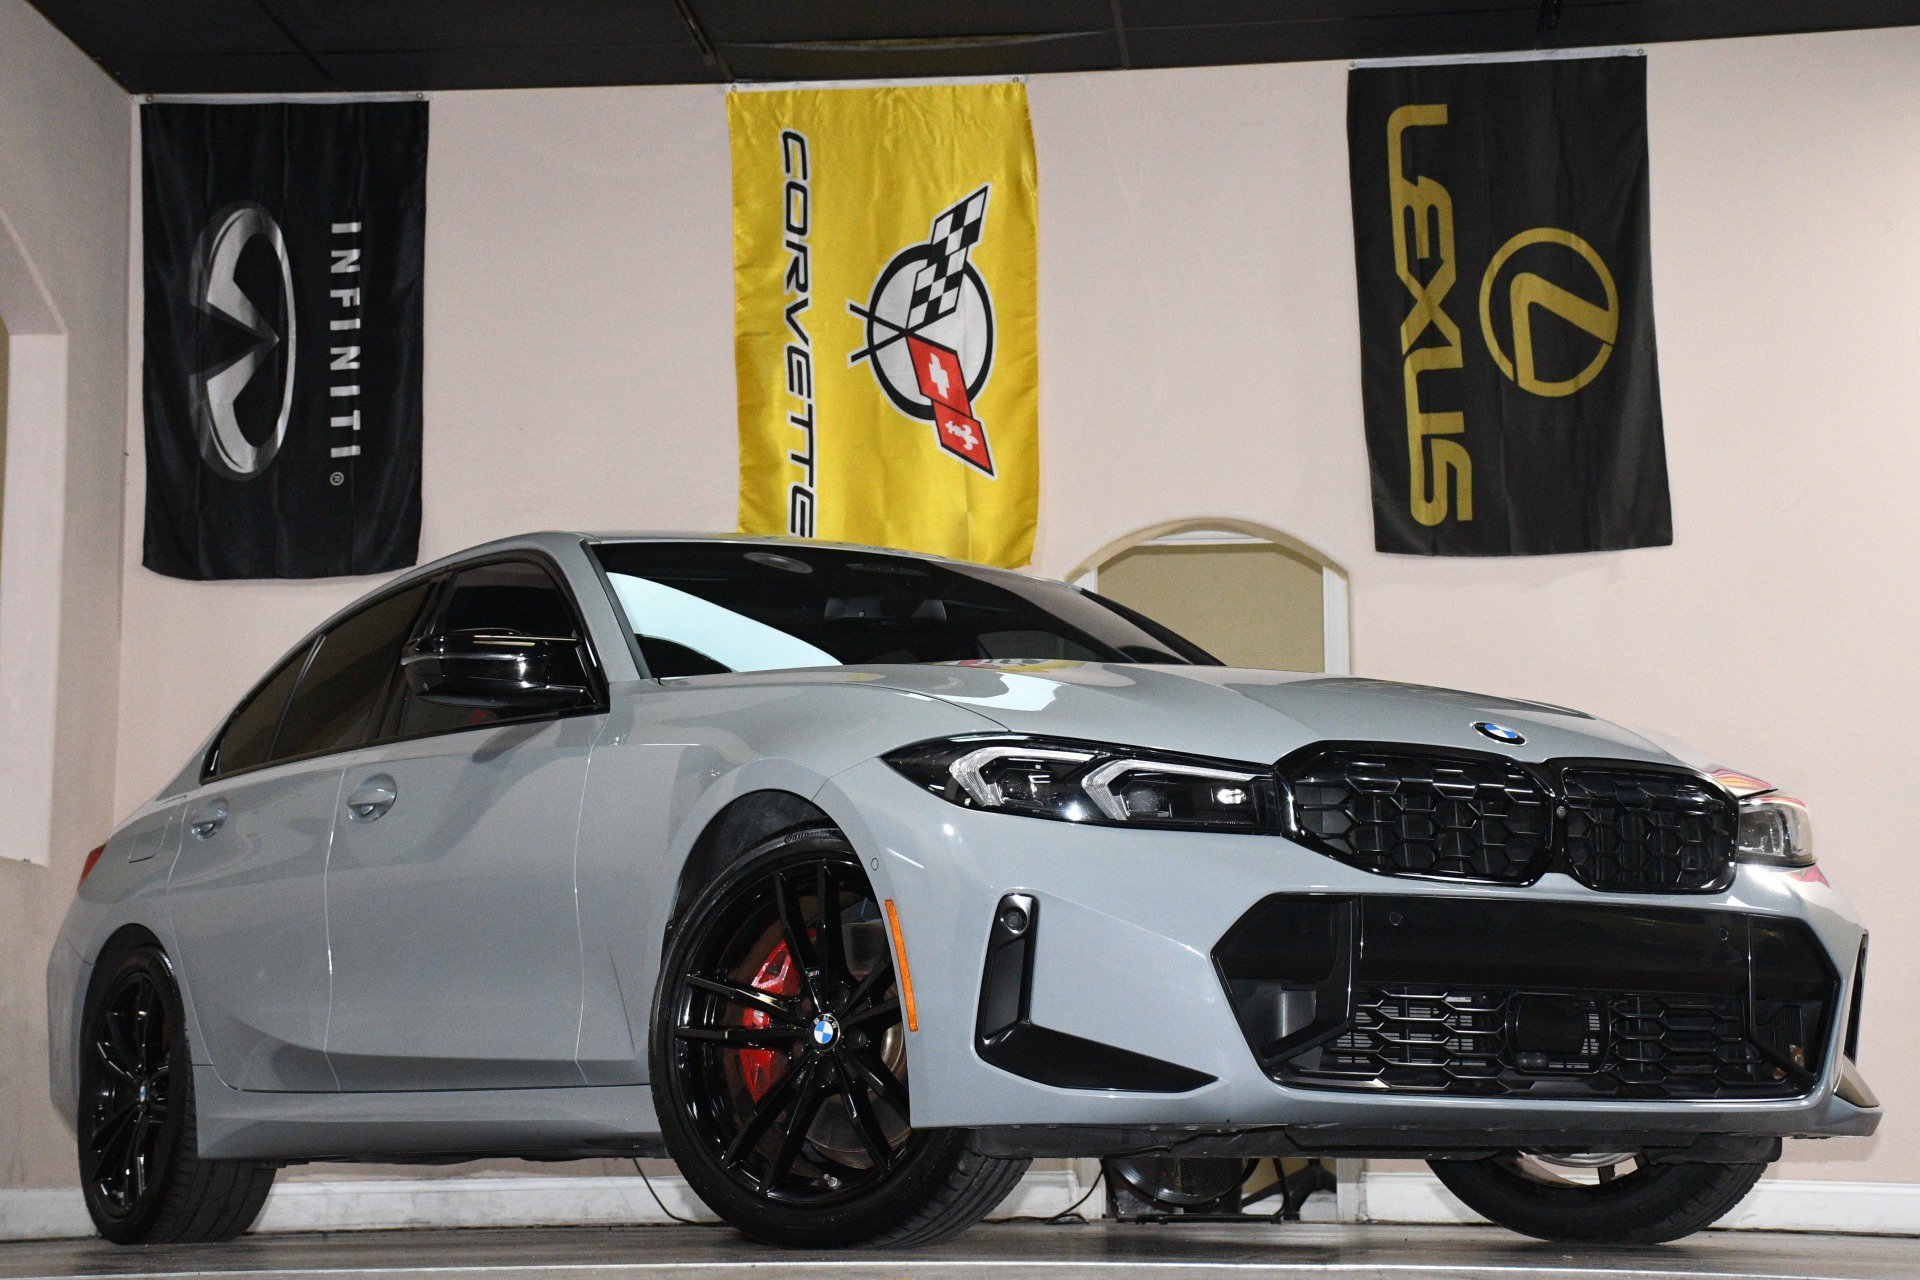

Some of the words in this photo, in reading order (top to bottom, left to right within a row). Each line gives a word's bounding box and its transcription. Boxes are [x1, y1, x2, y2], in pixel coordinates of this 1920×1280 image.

[330, 221, 362, 459] INFINITI
[782, 131, 815, 538] CORVETTE
[1386, 104, 1474, 527] LEXUS
